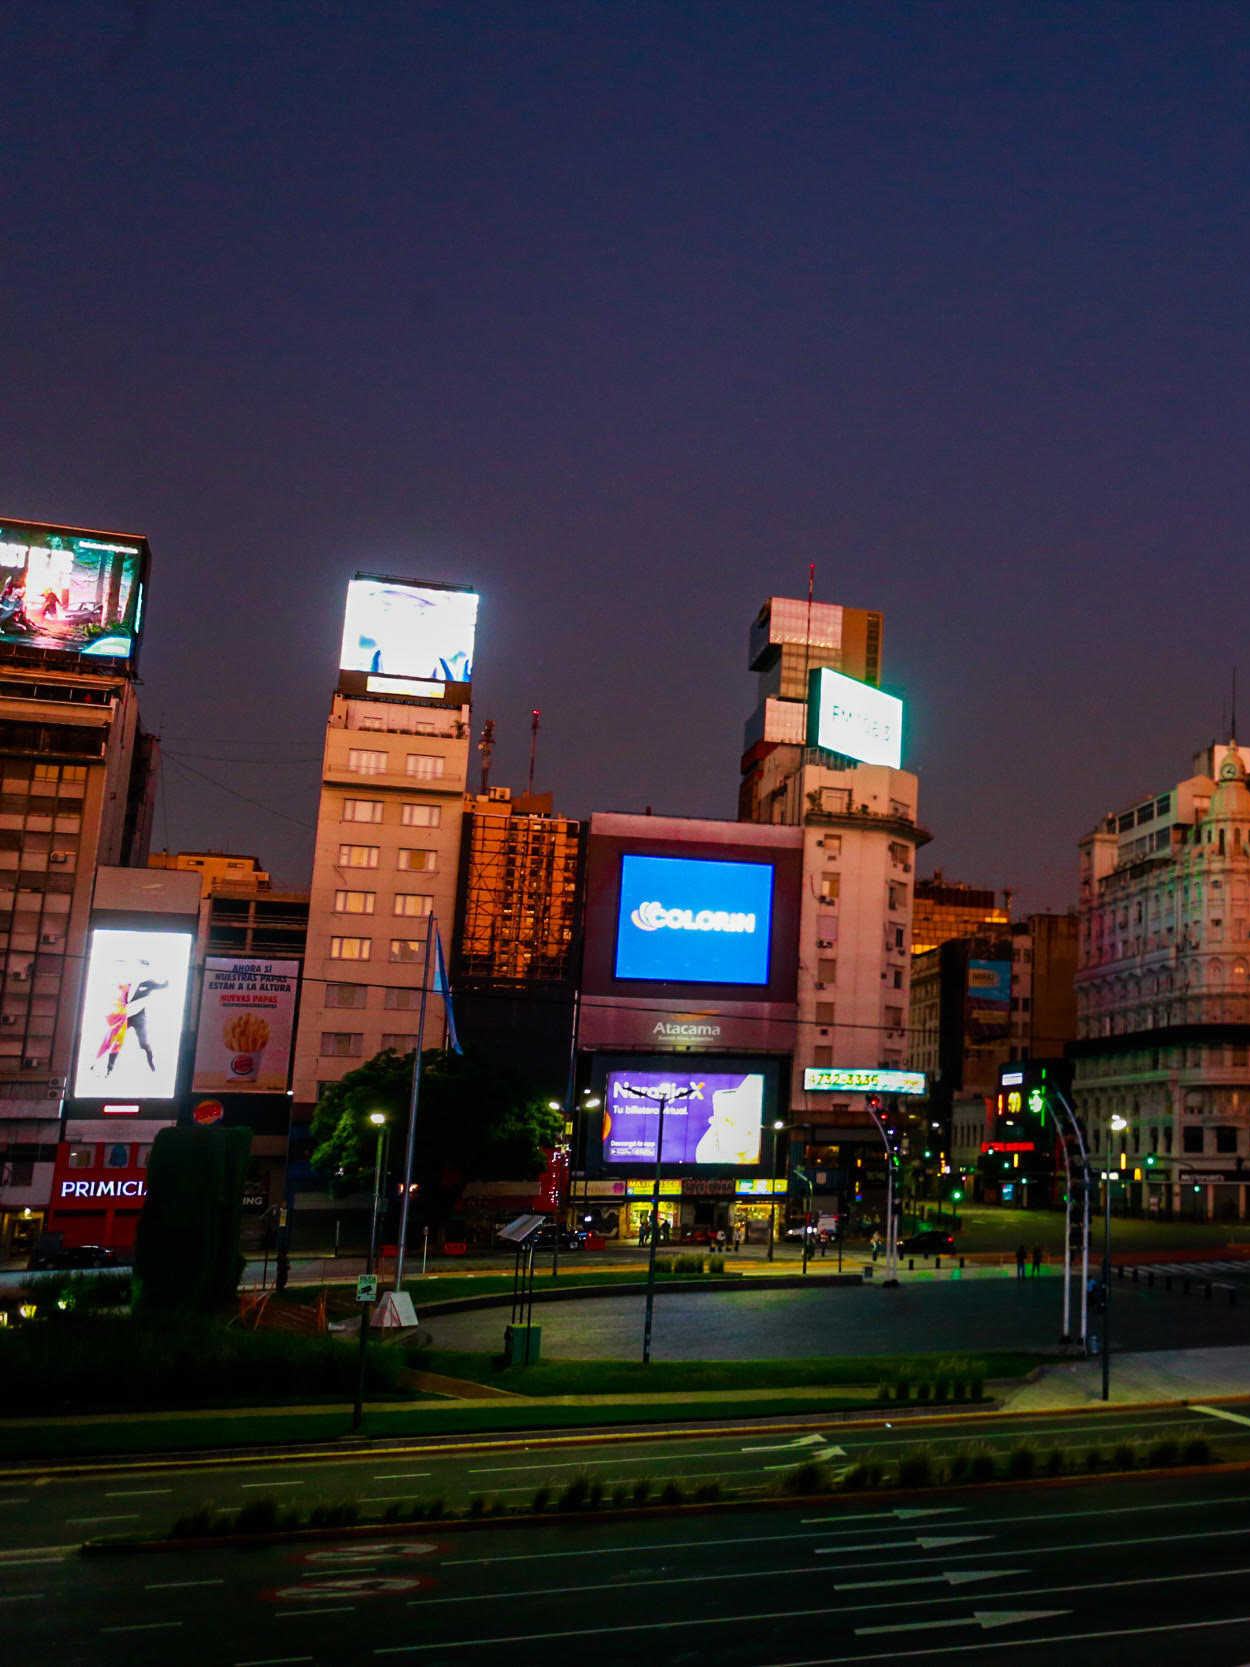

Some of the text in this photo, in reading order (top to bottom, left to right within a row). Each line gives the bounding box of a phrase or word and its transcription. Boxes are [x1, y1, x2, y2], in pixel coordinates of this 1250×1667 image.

[232, 964, 261, 973] AHORA
[215, 973, 288, 983] NUESTRAS PAPAS
[237, 982, 244, 990] A
[246, 983, 257, 991] LA
[260, 983, 291, 992] ALTURA
[220, 994, 278, 1003] NUEVAS PAPAS
[652, 1022, 721, 1036] Atacama
[613, 1105, 623, 1114] Tu
[61, 1180, 148, 1197] PRIMICI
[242, 1196, 263, 1206] ING
